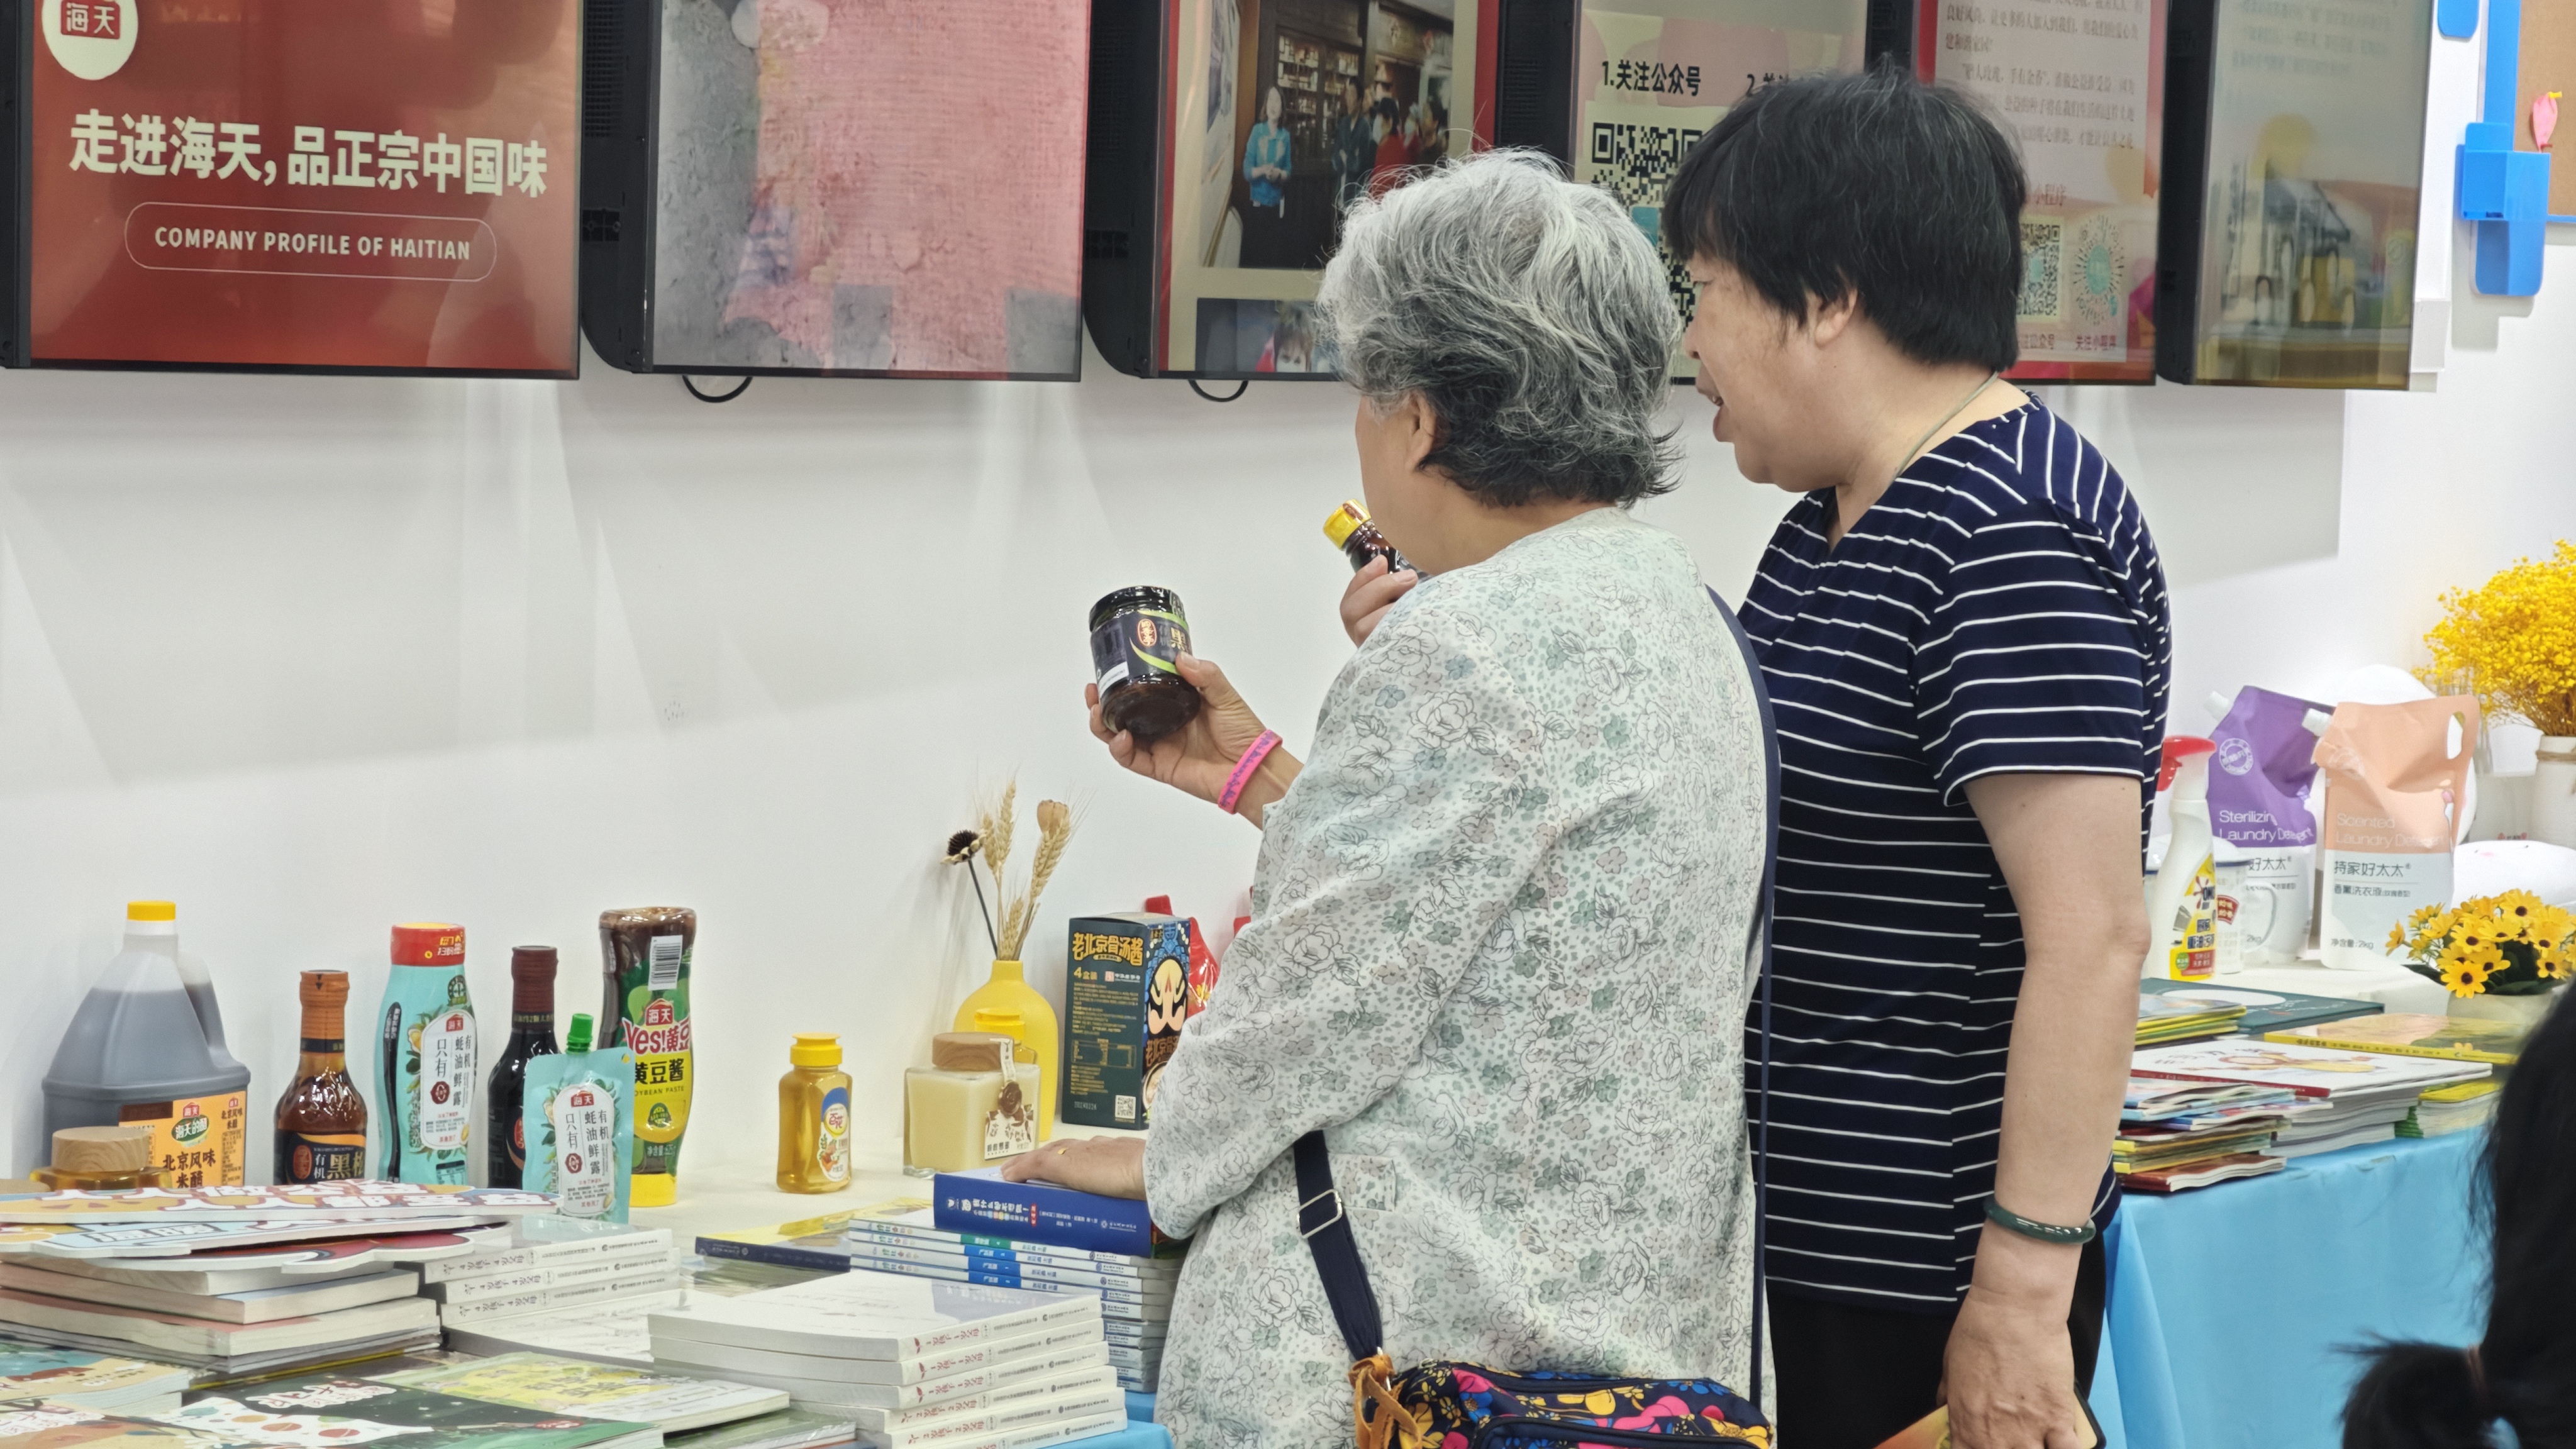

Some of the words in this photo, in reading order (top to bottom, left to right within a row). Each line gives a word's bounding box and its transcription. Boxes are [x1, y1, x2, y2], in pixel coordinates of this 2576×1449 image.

[65, 2, 116, 36] 海天
[1602, 59, 1702, 97] 1.关注公众号
[154, 226, 258, 252] COMPANY
[264, 231, 350, 255] PROFILE
[357, 236, 384, 257] OF
[390, 238, 470, 260] HAITIAN
[2336, 812, 2396, 829] Scented
[2219, 828, 2277, 843] Laundry
[2335, 831, 2392, 849] Laundry
[2334, 860, 2404, 877] 持家好太太
[1072, 932, 1144, 967] 老北京骨汤酱
[648, 1008, 672, 1024] 海天
[435, 1038, 448, 1078] 只有
[635, 1058, 685, 1085] 黄豆酱
[573, 1094, 593, 1106] 海天
[635, 1088, 663, 1097] OYBEAN
[665, 1085, 685, 1094] PASTE
[565, 1113, 579, 1150] 只有
[598, 1109, 609, 1140] 有机
[584, 1110, 601, 1175] 蚝油鲜露
[162, 1148, 216, 1171] 北京风味
[314, 1153, 326, 1180] 有机
[176, 1170, 204, 1189] 米醋
